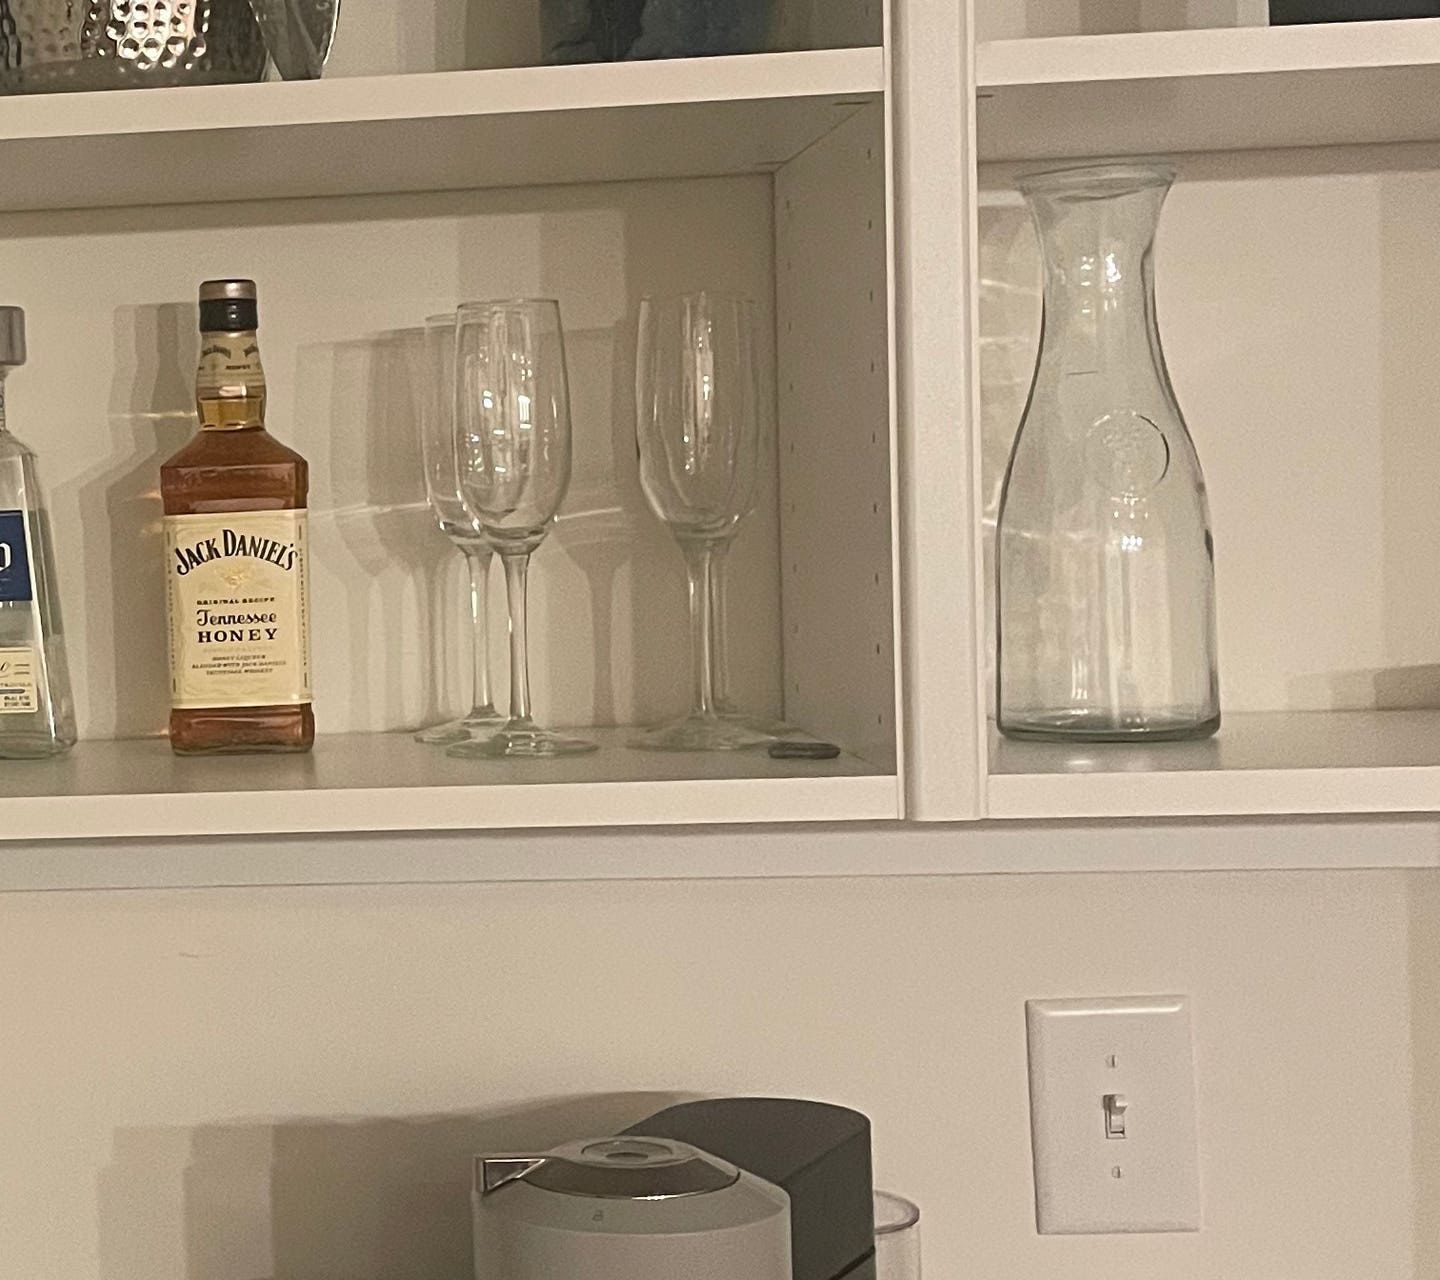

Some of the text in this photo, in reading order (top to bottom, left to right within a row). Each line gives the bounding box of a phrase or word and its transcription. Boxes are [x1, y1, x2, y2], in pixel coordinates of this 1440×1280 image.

[174, 529, 299, 576] JACK DANIEL'S
[196, 609, 278, 627] Tennessee
[197, 627, 279, 644] HONEY
